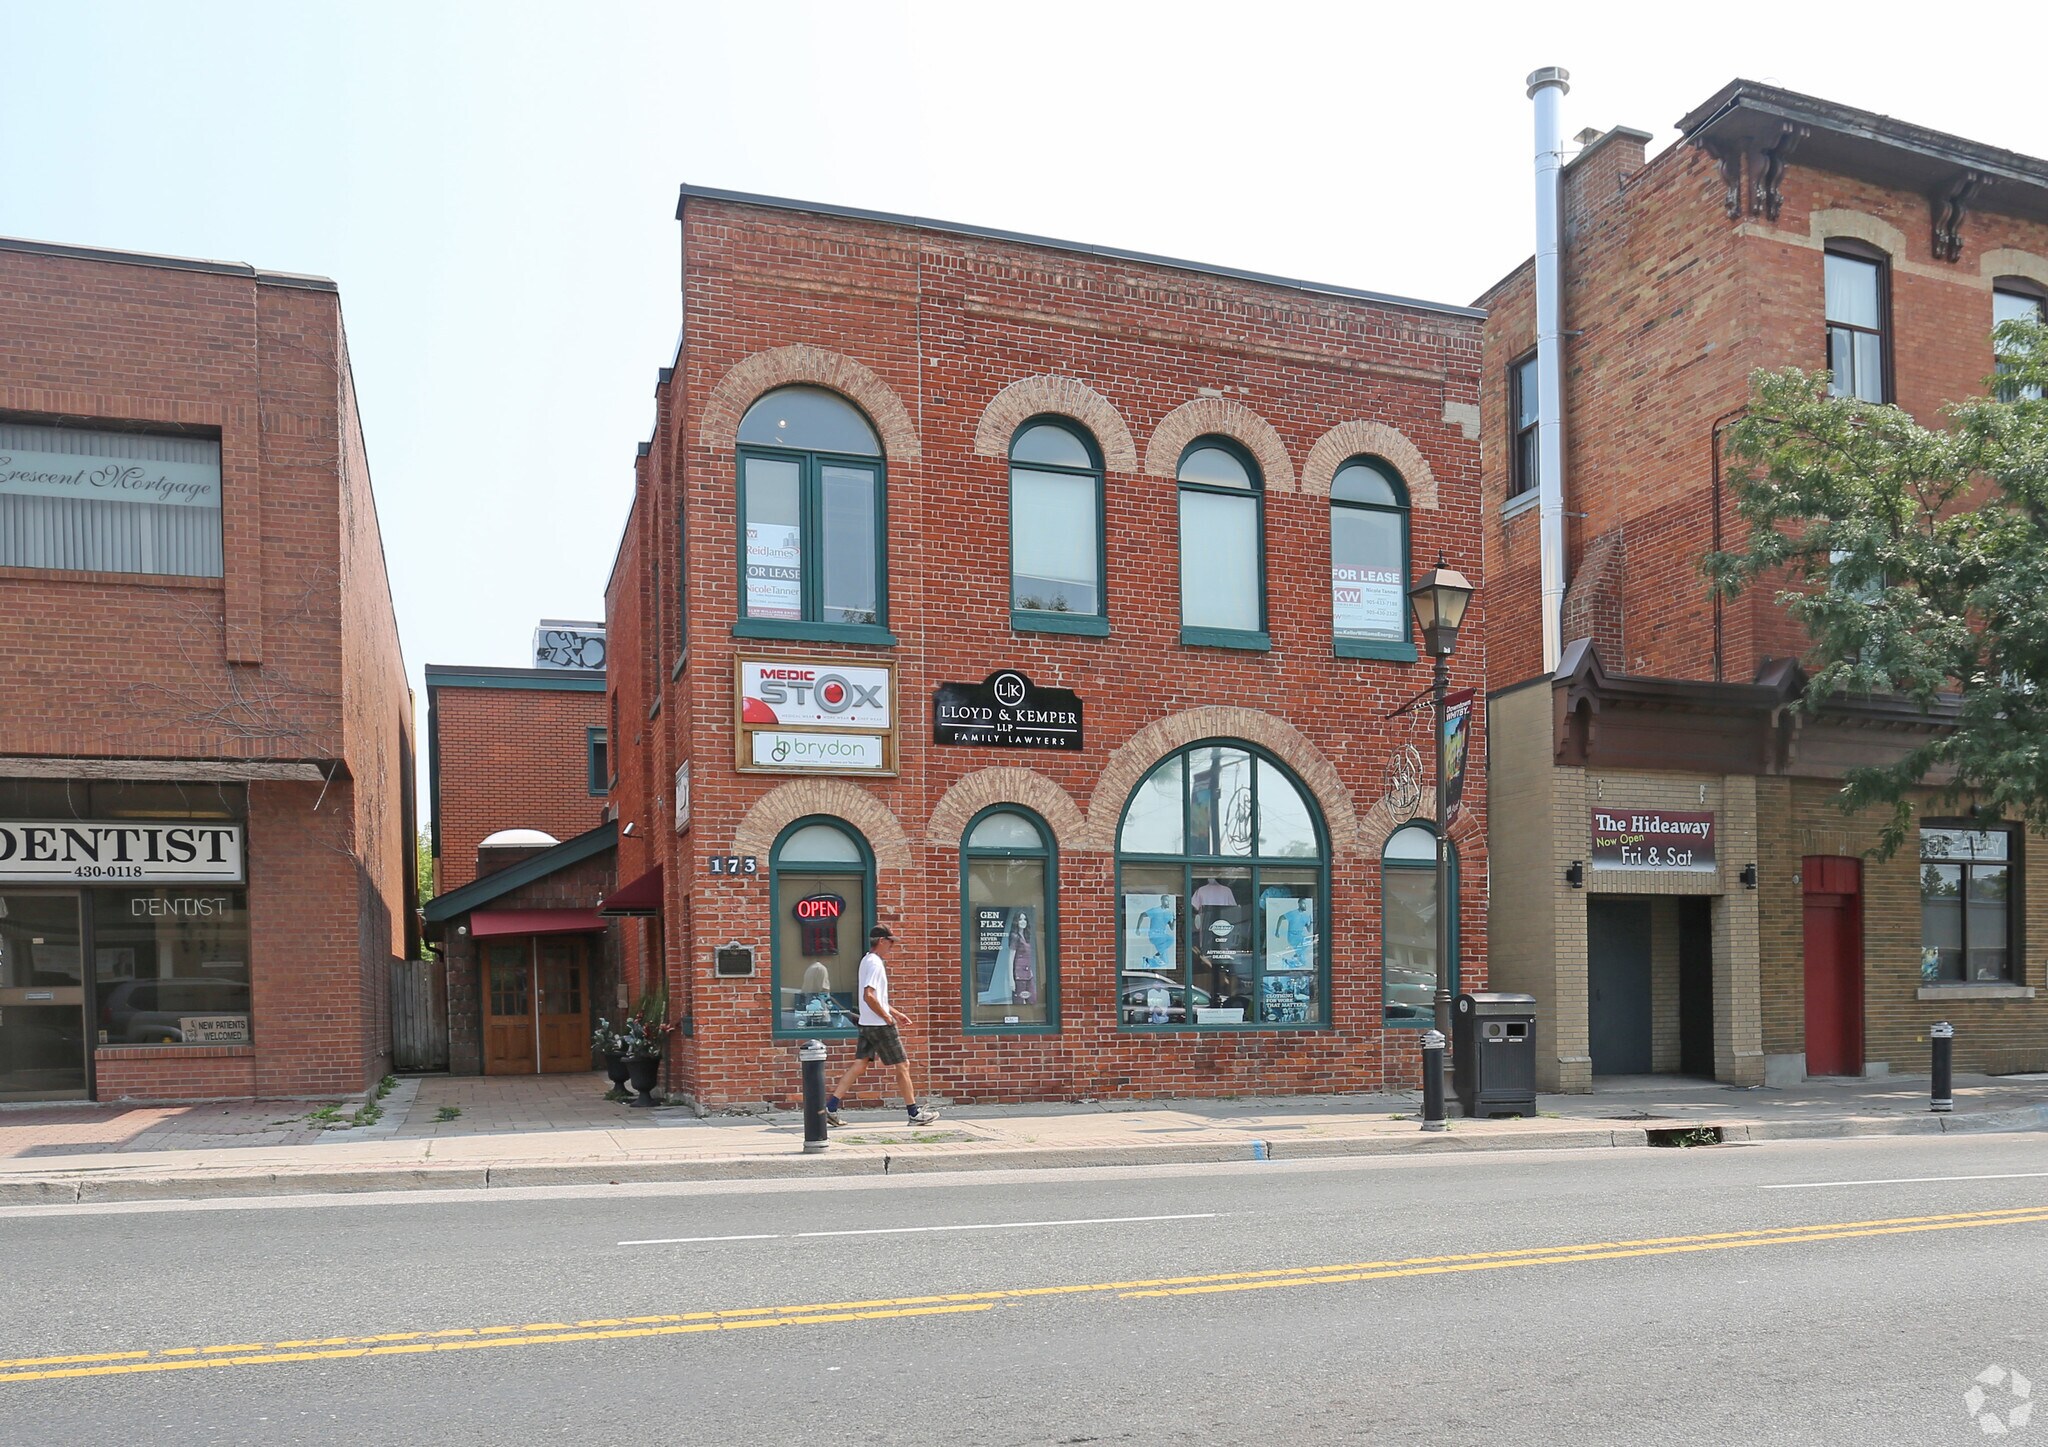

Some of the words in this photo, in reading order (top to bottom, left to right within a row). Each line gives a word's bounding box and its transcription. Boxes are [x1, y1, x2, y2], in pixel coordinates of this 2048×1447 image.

[90, 464, 212, 503] Mortgage
[769, 568, 800, 580] LEASE
[1332, 568, 1357, 580] FOR
[1361, 570, 1400, 583] LEASE
[1334, 590, 1360, 602] KW
[760, 668, 815, 681] MEDIC
[760, 673, 883, 714] STOX
[941, 706, 992, 720] LLOYD
[999, 709, 1011, 721] &
[1016, 710, 1077, 724] KEMPER
[997, 724, 1013, 732] LLP
[954, 733, 1000, 742] FAMILY
[1008, 735, 1065, 745] LAWYERS
[795, 738, 864, 759] brydon
[1595, 814, 1626, 832] The
[1630, 815, 1710, 839] Hideaway
[1596, 837, 1617, 848] Now
[1619, 833, 1645, 846] Open
[1621, 846, 1642, 865] Fri
[1647, 846, 1661, 866] &
[1666, 847, 1693, 866] Sat
[74, 866, 142, 878] 430-0118
[711, 859, 756, 872] 173
[131, 898, 227, 916] DENTIST
[798, 900, 838, 918] OPEN
[980, 911, 1000, 919] GEN
[980, 920, 1004, 928] FLEX
[198, 1021, 214, 1030] NEW
[215, 1020, 246, 1029] PATIENTS
[203, 1031, 242, 1040] WELCOMED
